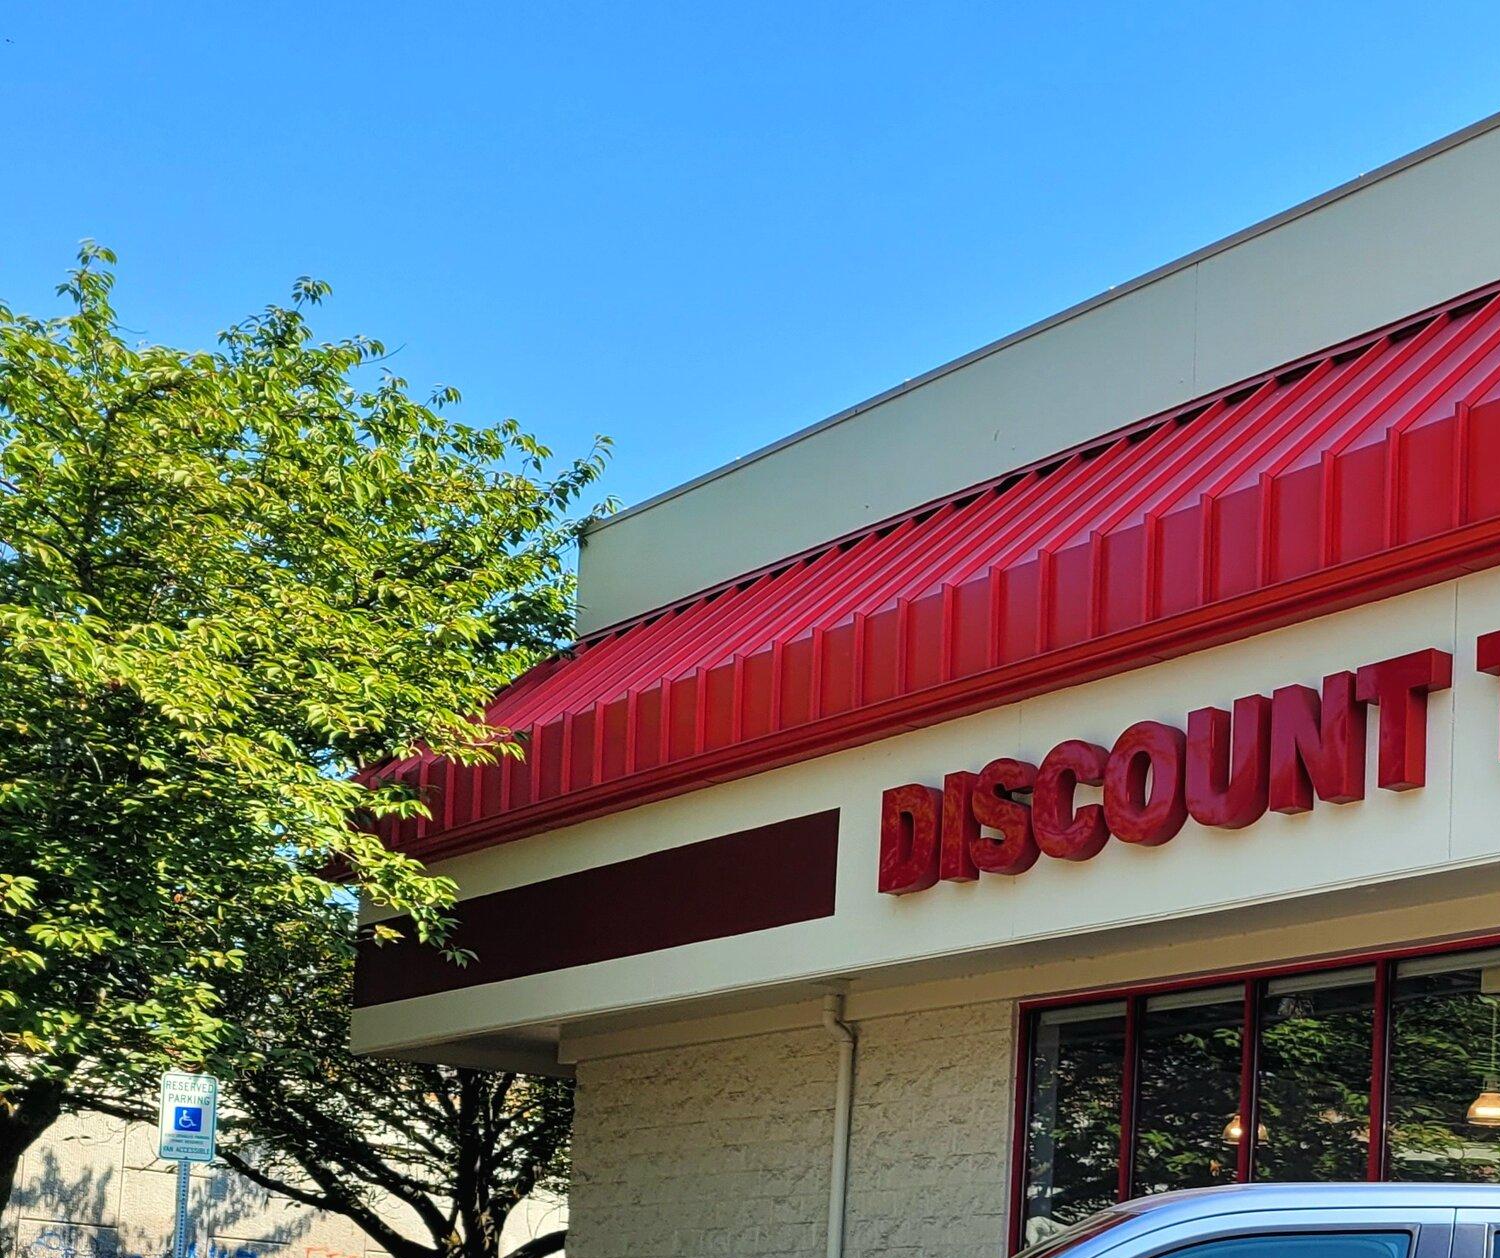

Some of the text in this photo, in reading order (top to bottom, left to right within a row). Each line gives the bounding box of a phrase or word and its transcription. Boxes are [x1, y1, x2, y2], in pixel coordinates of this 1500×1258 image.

[878, 648, 1452, 895] DISCOUNT
[165, 1080, 213, 1093] RESERVED
[168, 1094, 210, 1106] PARKING
